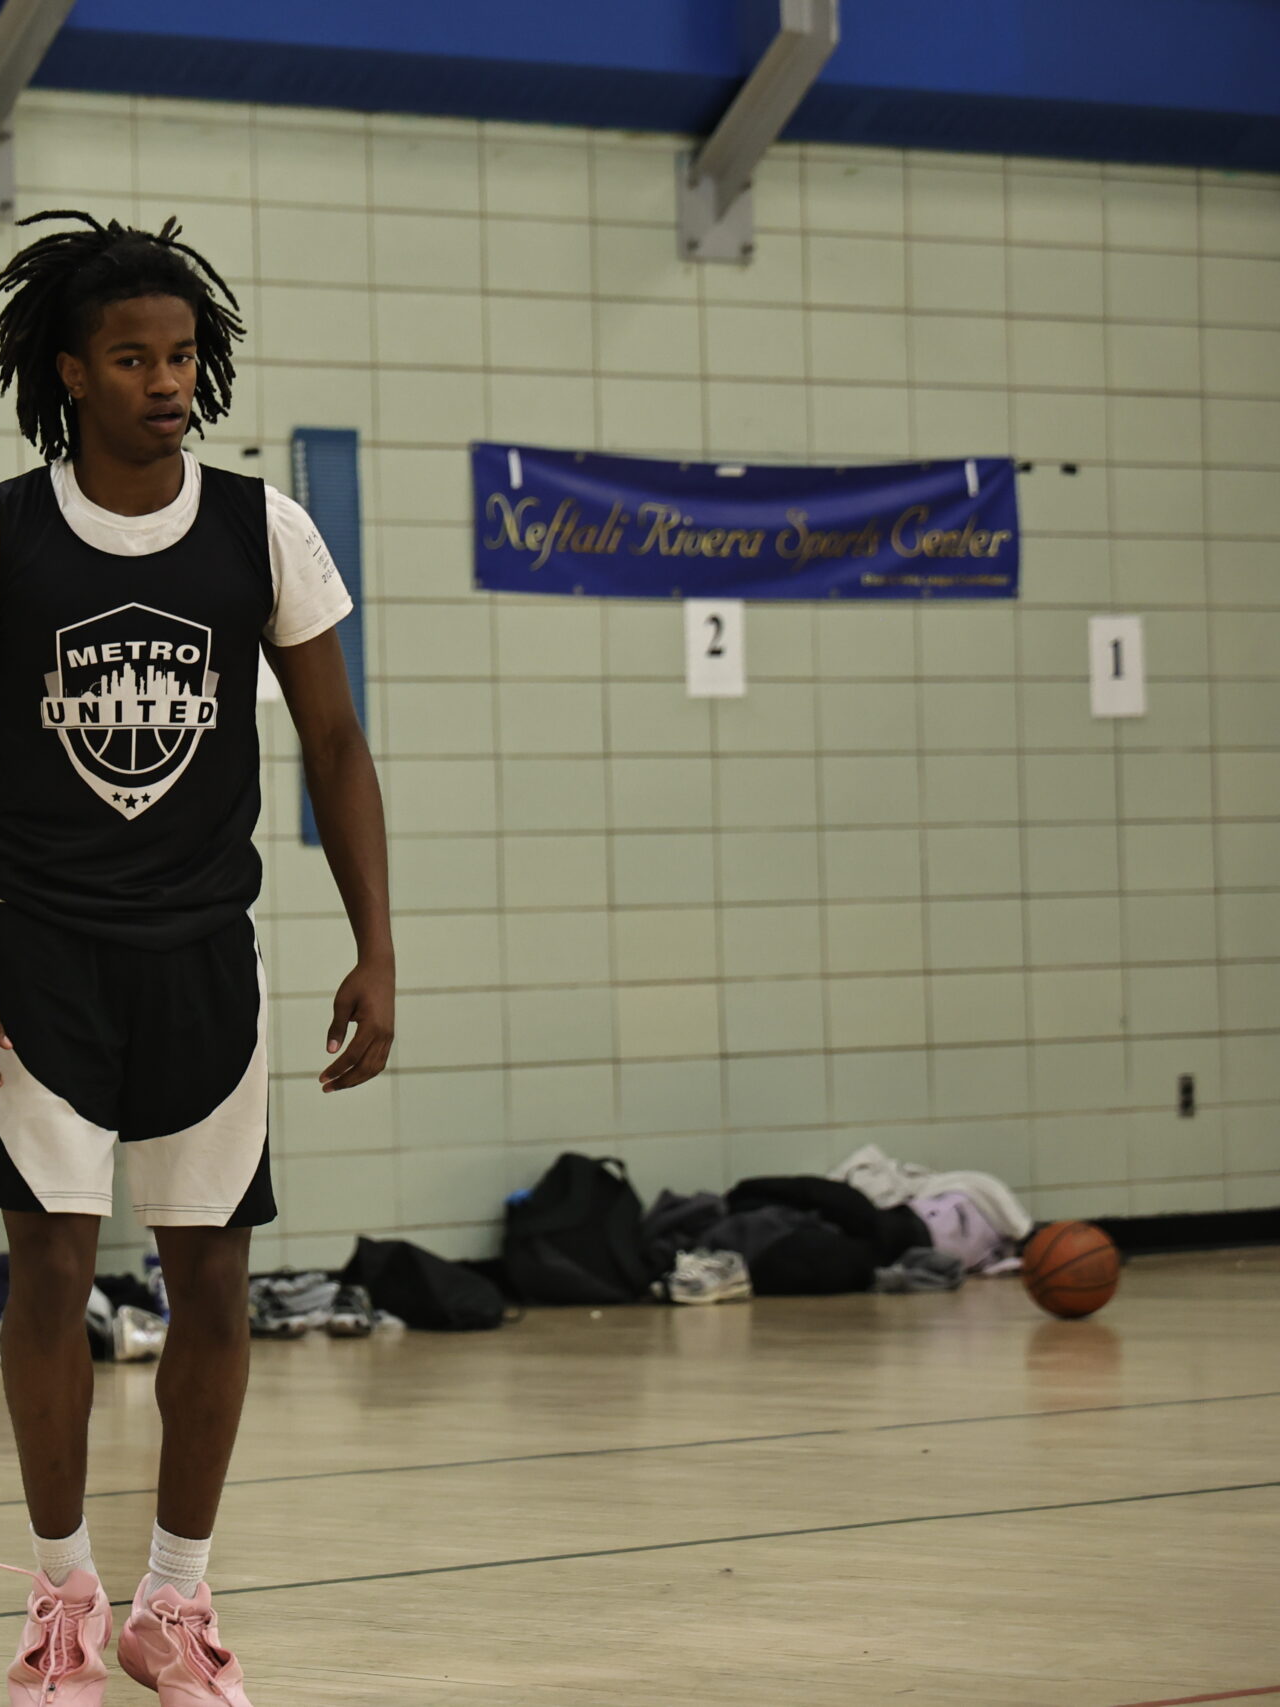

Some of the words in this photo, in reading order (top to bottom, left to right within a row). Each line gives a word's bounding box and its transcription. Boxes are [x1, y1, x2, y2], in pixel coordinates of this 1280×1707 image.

[629, 502, 765, 558] Rivera
[775, 507, 881, 572] Sports
[890, 505, 1012, 558] Center
[66, 641, 201, 667] METRO
[704, 613, 727, 659] 2
[1109, 637, 1125, 681] 1
[46, 700, 214, 724] UNITED
